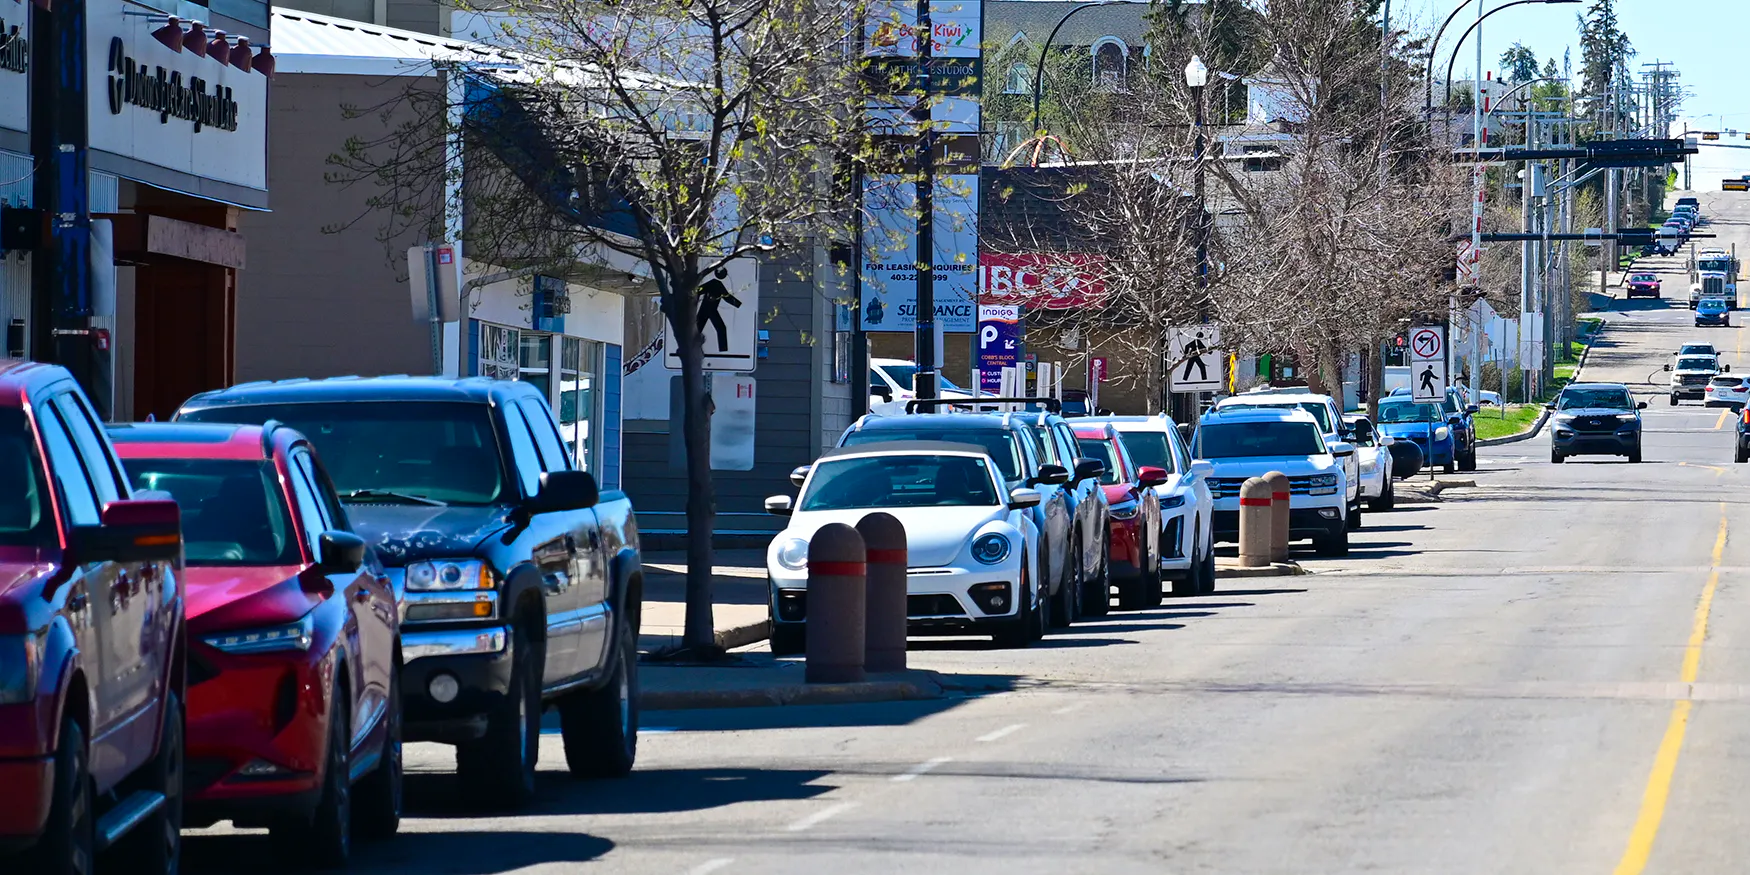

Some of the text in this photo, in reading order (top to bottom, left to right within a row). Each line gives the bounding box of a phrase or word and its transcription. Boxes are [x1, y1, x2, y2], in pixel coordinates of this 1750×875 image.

[934, 23, 962, 37] Kiwi
[911, 39, 942, 52] Cfe
[906, 64, 937, 74] HOE
[938, 64, 974, 75] STUDIOS
[865, 263, 974, 272] FOR LEASI NQUIRIES
[979, 265, 1037, 298] IBC
[897, 304, 972, 317] SUANCE
[982, 309, 1014, 317] INDIGO
[980, 325, 998, 350] P
